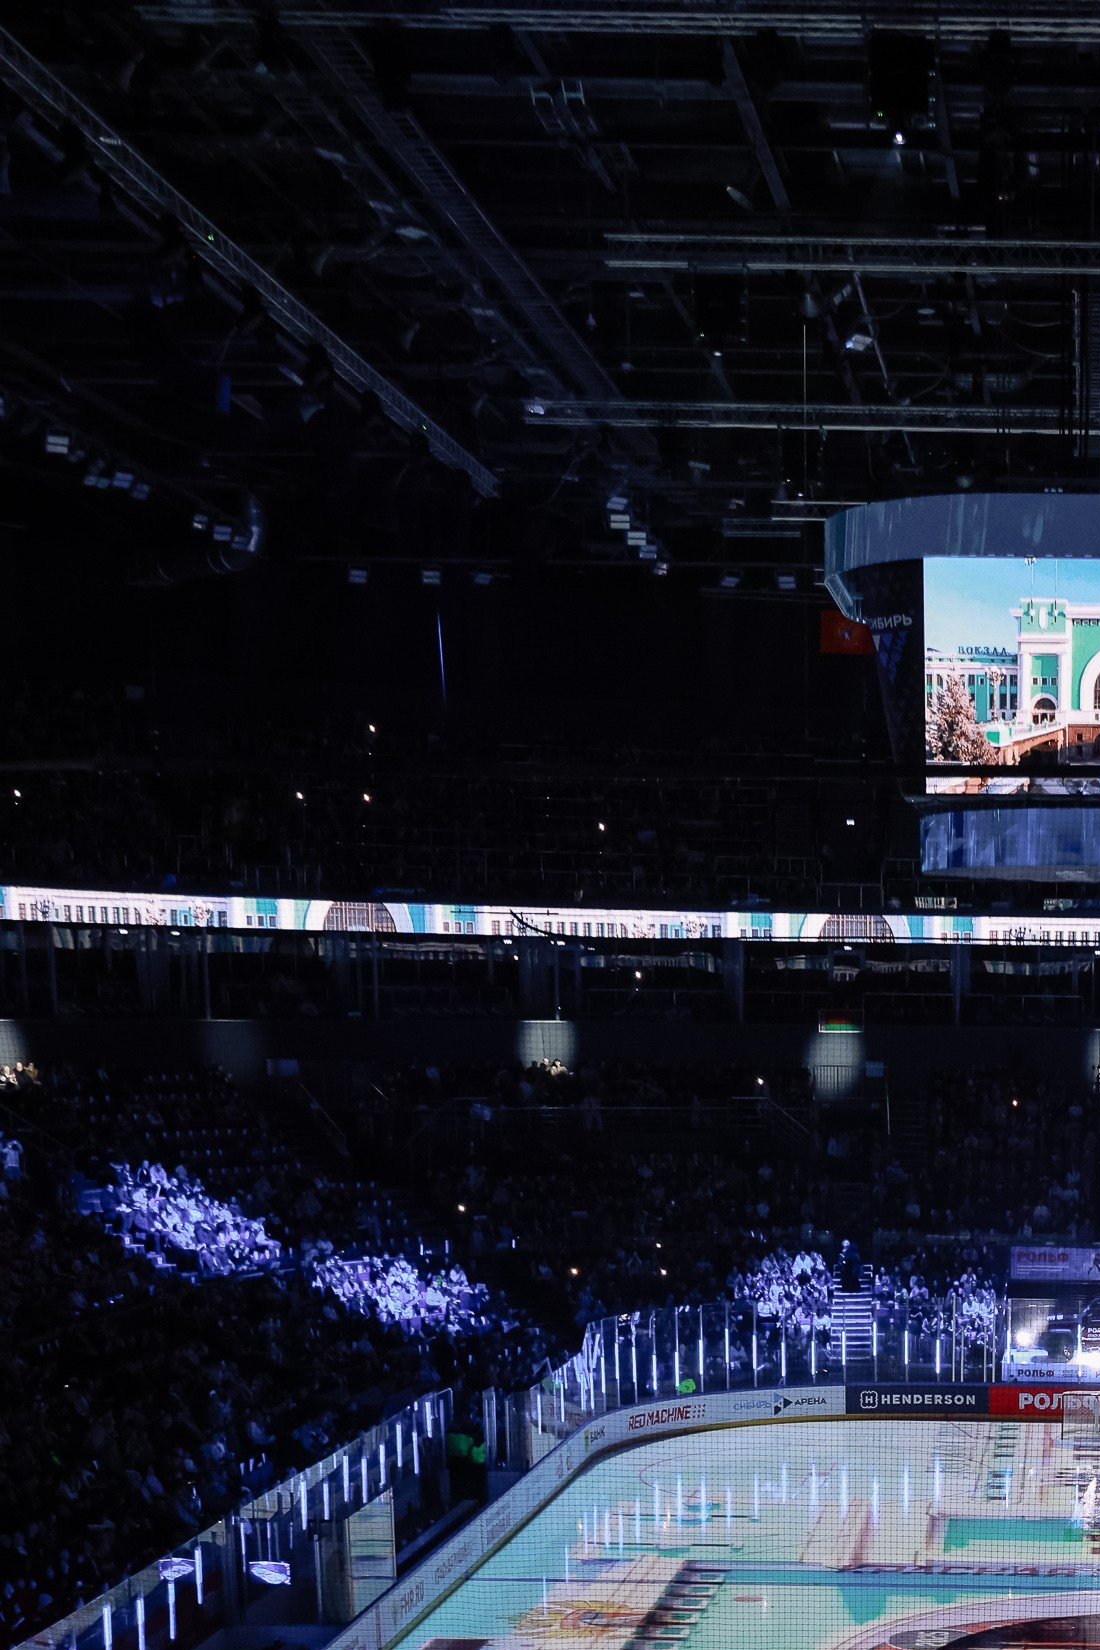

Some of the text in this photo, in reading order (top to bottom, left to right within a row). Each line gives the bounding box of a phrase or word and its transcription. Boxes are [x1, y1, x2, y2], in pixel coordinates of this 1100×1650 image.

[958, 645, 1009, 655] ВОКЗАЛ
[1017, 1369, 1054, 1377] РОЛЬФ
[794, 1397, 827, 1407] АРЕНА
[881, 1393, 976, 1406] HENDERSON
[646, 1405, 691, 1426] MACHINE
